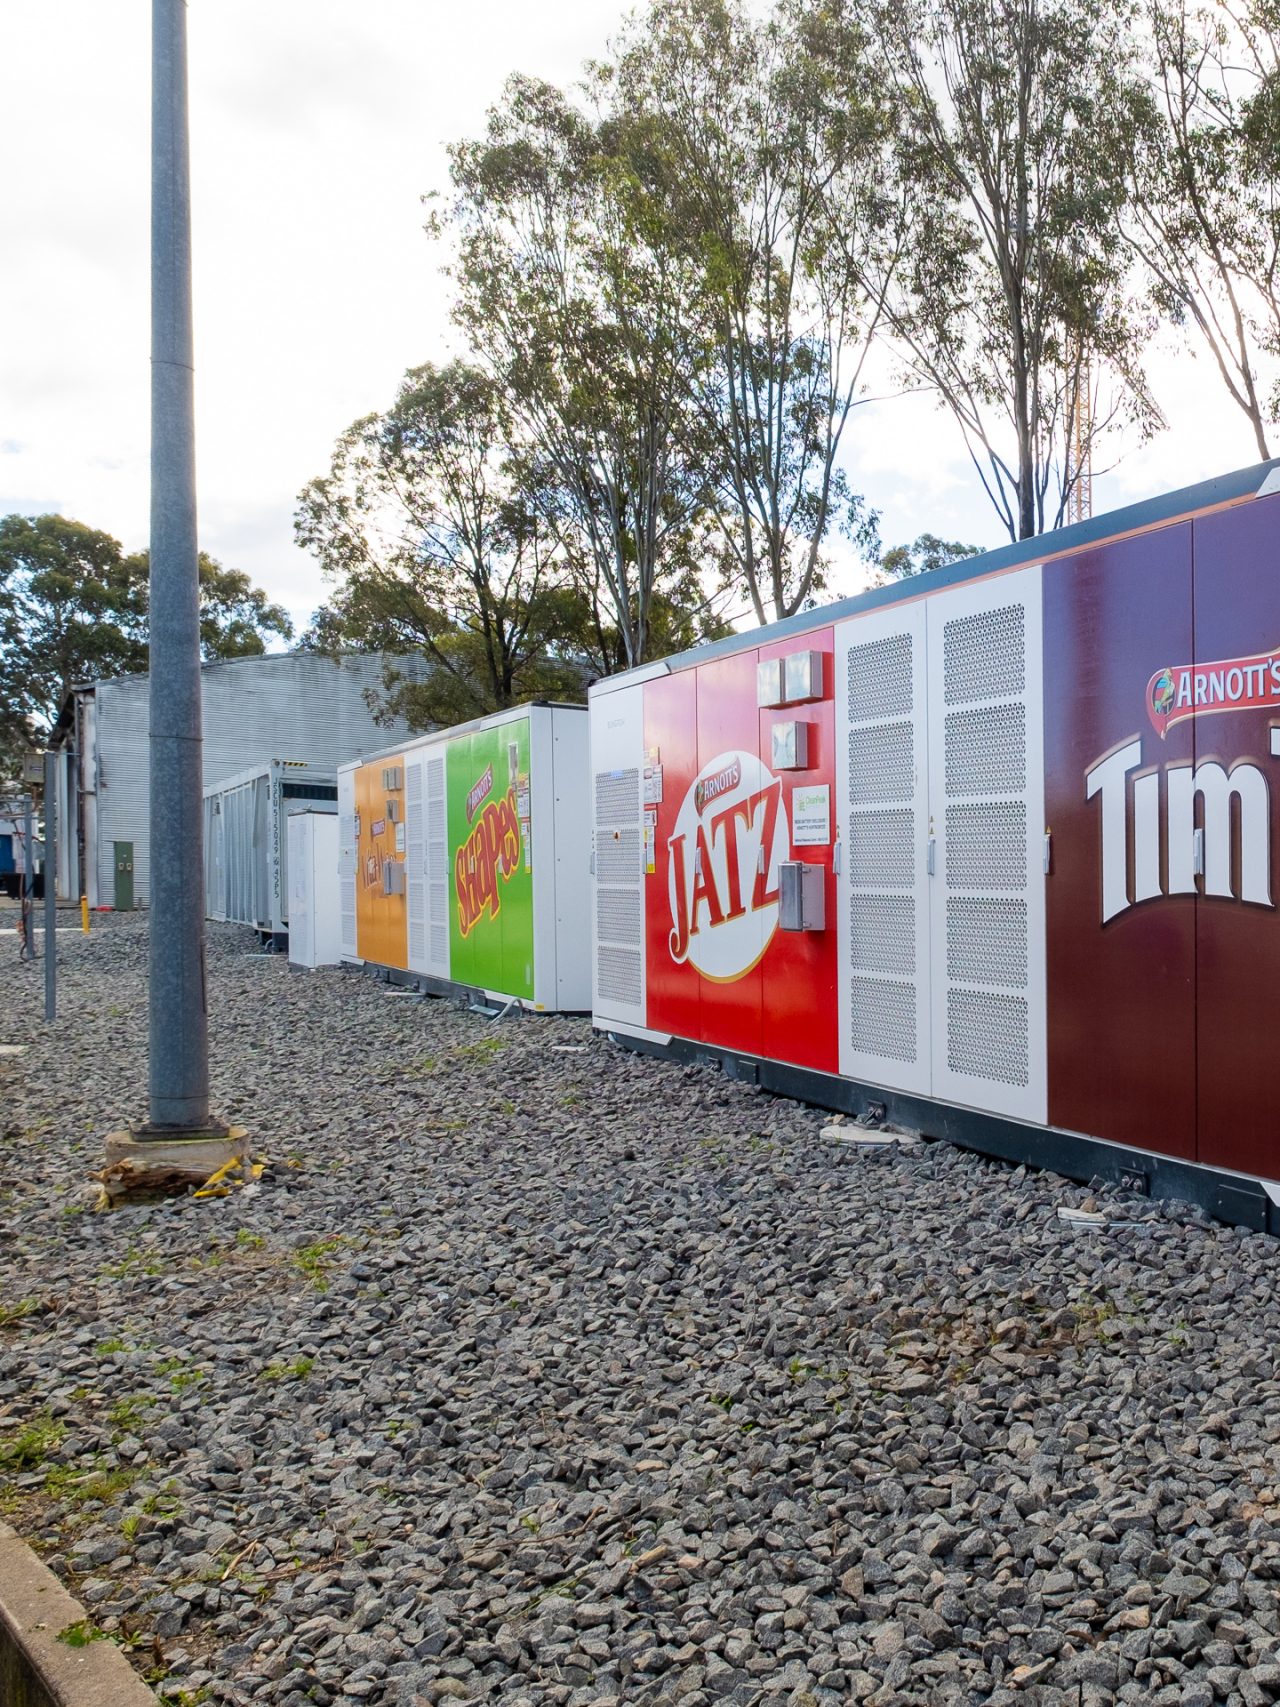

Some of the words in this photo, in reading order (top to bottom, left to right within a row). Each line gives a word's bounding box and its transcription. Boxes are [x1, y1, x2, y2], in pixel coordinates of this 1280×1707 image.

[669, 780, 783, 962] JATZ
[704, 762, 739, 801] ARNOTT'S
[1085, 738, 1276, 928] Tim
